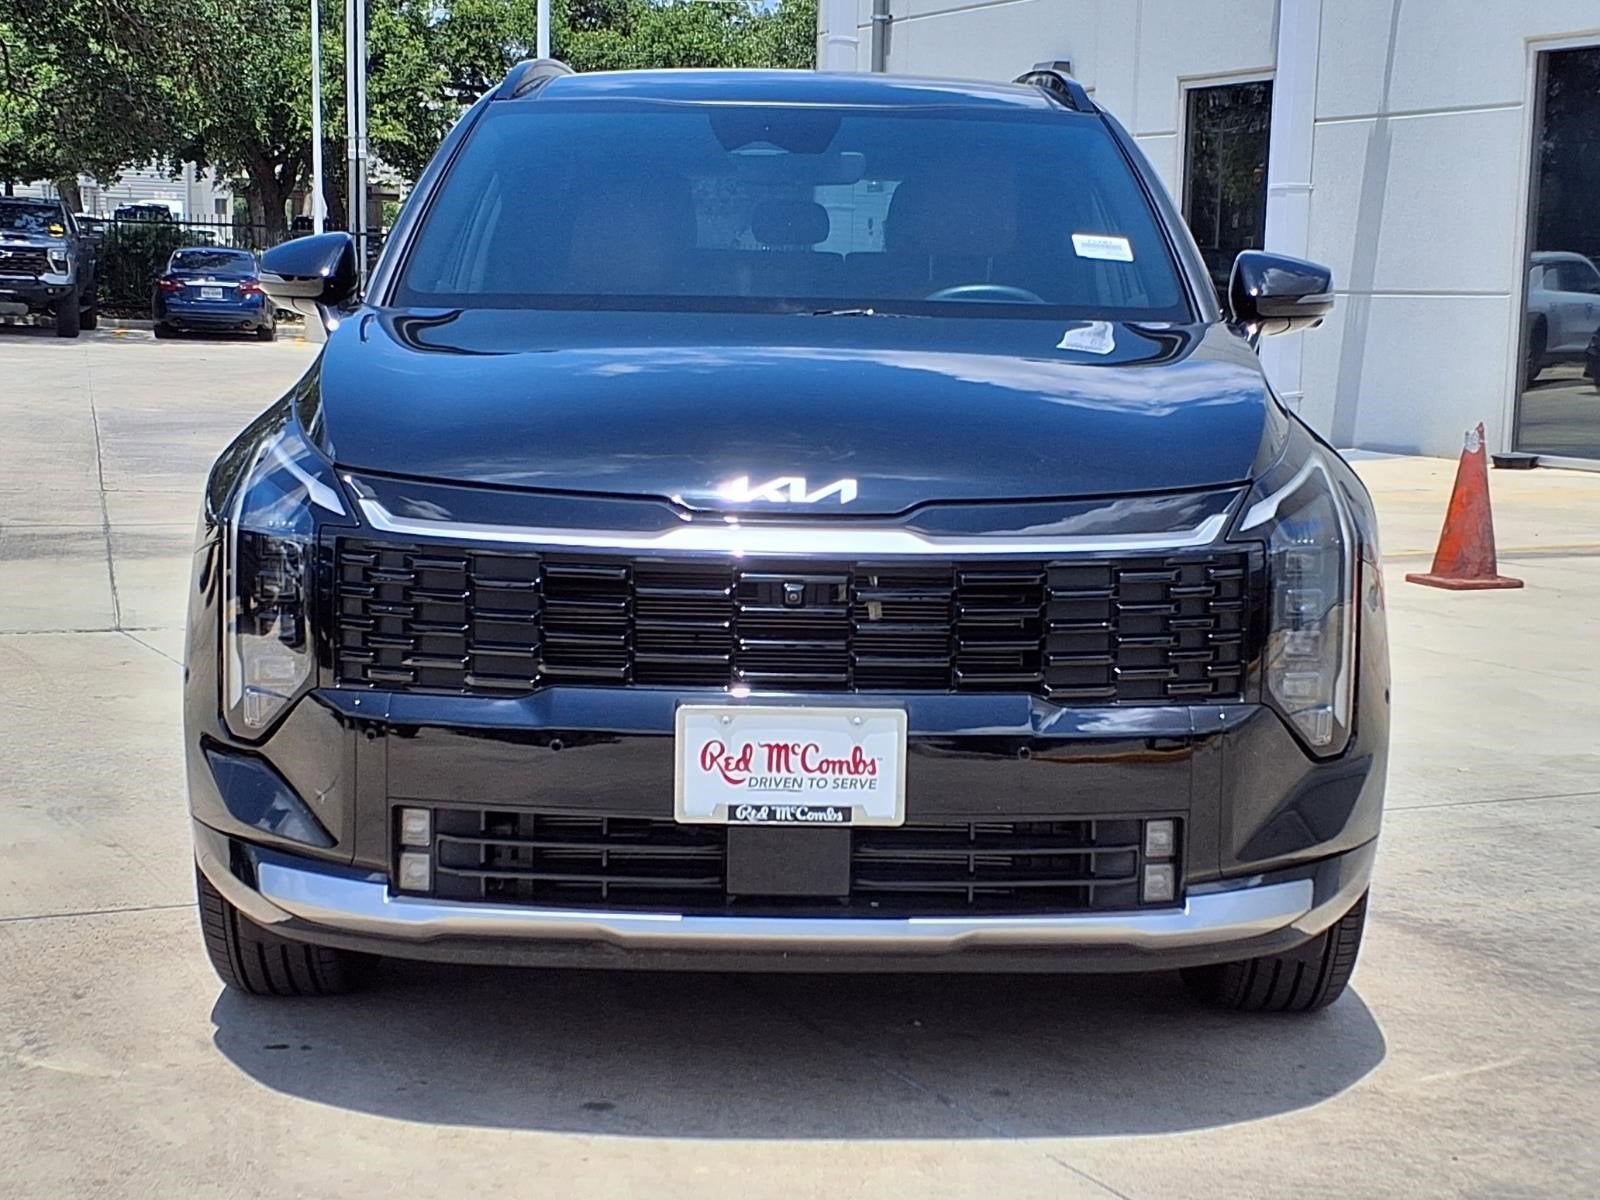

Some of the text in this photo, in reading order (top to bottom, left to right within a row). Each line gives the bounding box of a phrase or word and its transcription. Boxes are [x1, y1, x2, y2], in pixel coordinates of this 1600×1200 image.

[701, 740, 877, 784] Red McCombs
[748, 776, 877, 790] DRIVEN TO SERVE
[735, 804, 843, 821] Red McCombs
